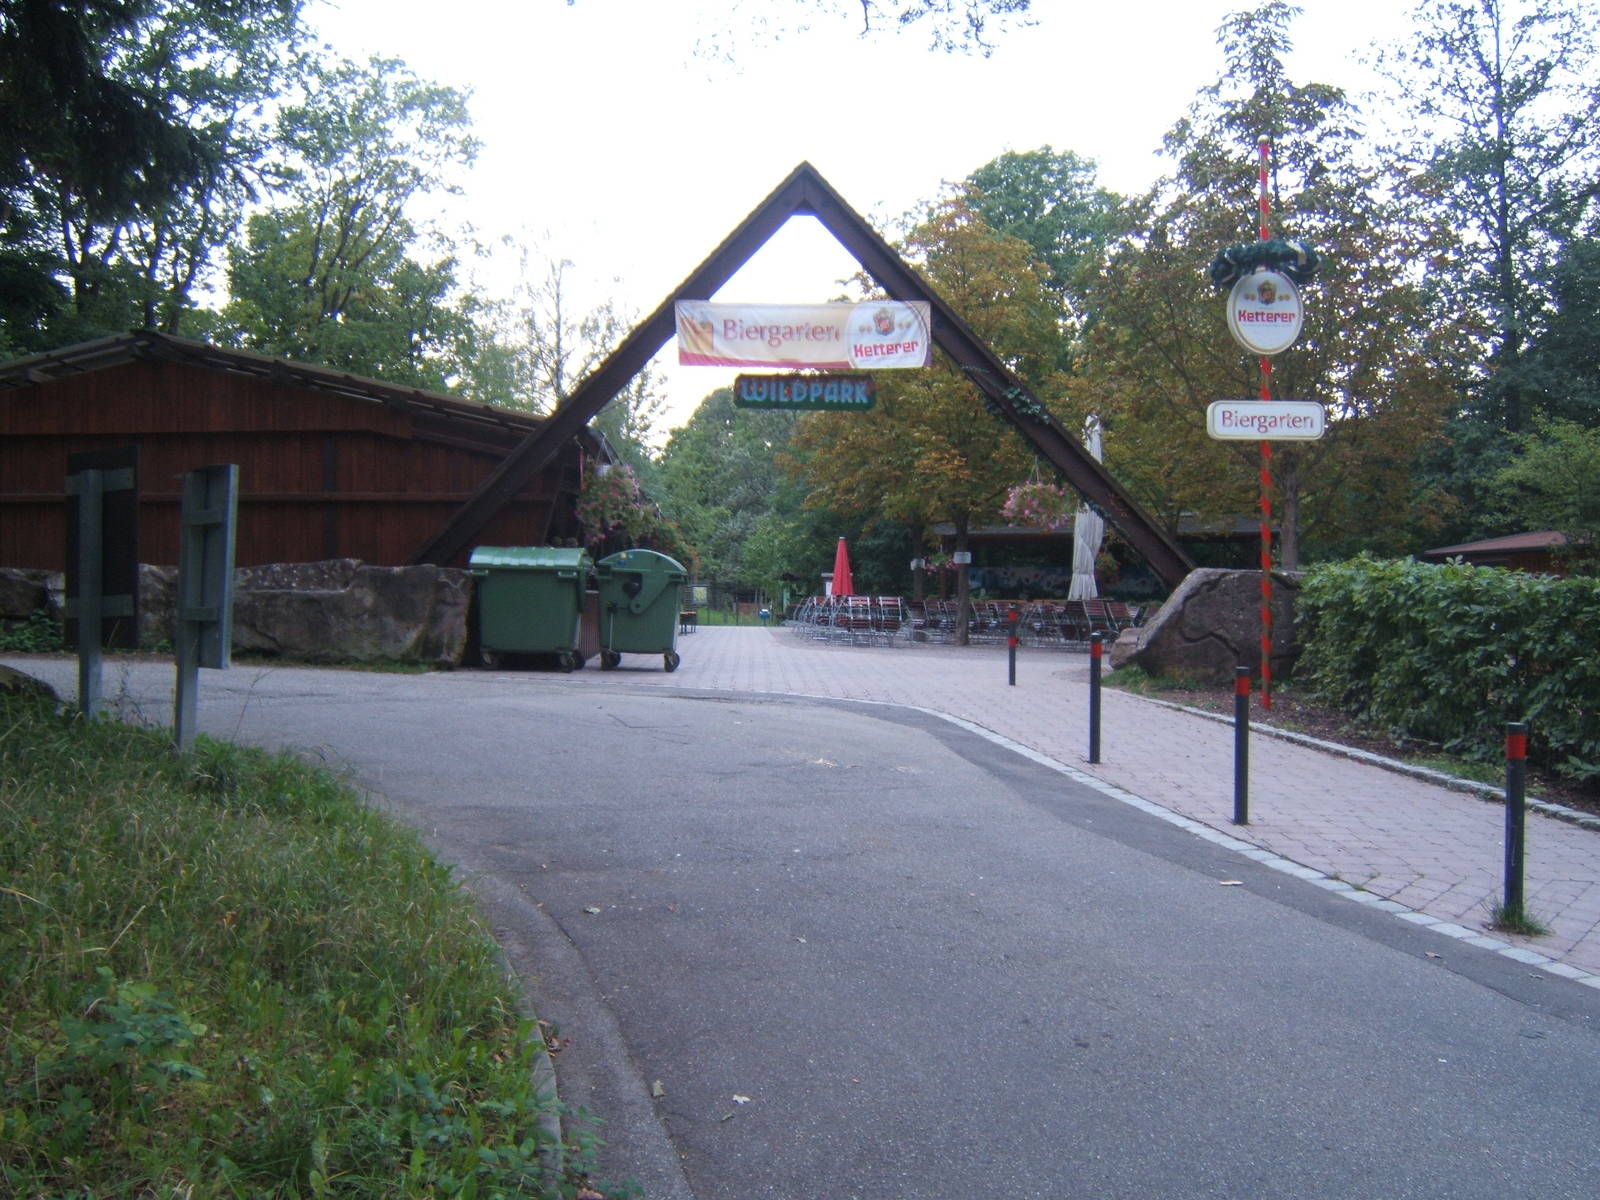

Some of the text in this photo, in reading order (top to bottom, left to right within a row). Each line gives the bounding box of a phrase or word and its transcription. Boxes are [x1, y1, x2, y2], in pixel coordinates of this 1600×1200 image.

[1238, 310, 1296, 323] Ketterer
[722, 319, 840, 348] Biergarten
[854, 340, 919, 357] Ketterer
[741, 380, 869, 404] WILDPARK
[1221, 410, 1314, 433] Biergarten
